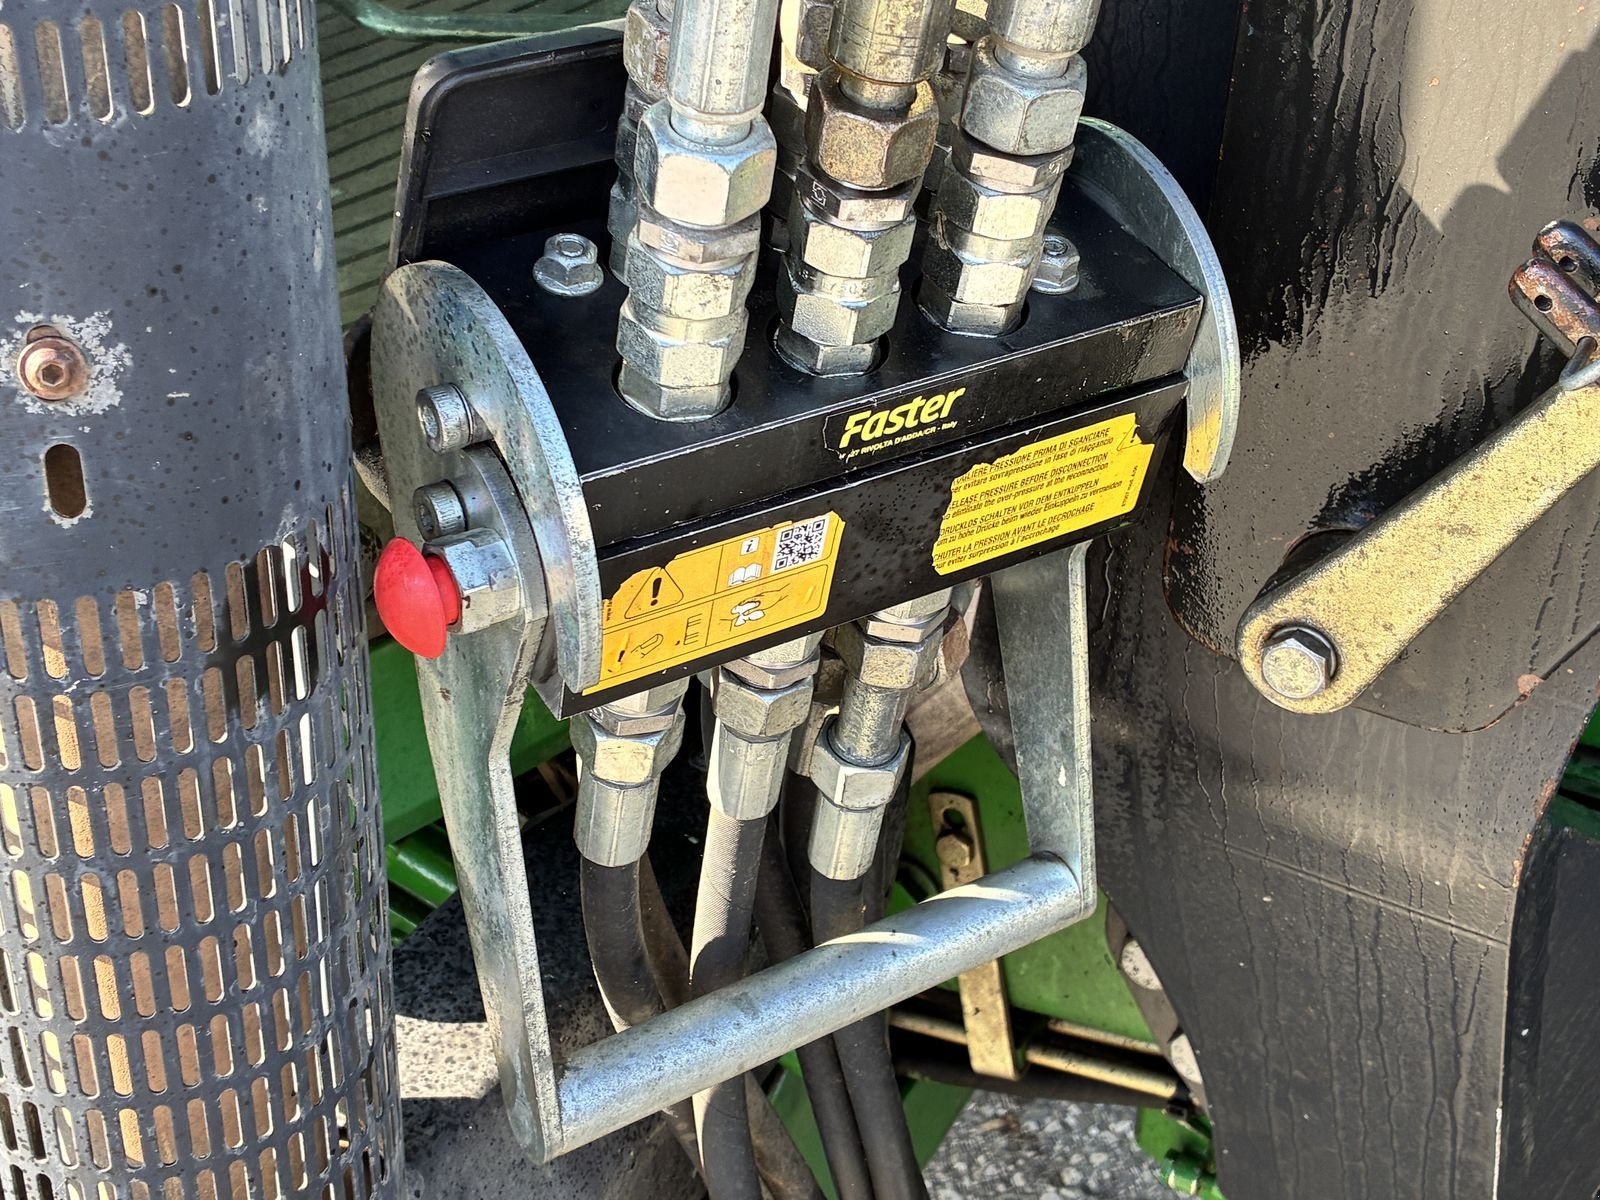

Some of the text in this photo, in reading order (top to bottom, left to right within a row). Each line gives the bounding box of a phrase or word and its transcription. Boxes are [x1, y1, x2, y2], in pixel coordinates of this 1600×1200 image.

[839, 387, 966, 449] Faster
[861, 439, 893, 455] RIVOLTA
[941, 420, 958, 431] Italy
[1033, 444, 1057, 460] PRIMA
[1059, 441, 1068, 451] DI
[1068, 428, 1110, 448] SGANCIARE
[979, 480, 1020, 500] PRESSURE
[1020, 470, 1050, 487] BEFORE
[1050, 452, 1108, 478] DISCONNECTION
[984, 498, 996, 508] the
[996, 483, 1044, 504] over-pressure
[1066, 462, 1109, 481] reconnection
[988, 459, 1043, 482] sovrapressione
[979, 505, 1017, 524] SCHALTEN
[1019, 499, 1035, 510] VOR
[1035, 493, 1052, 505] DEM
[1053, 478, 1099, 499] ENTKUPPELN
[962, 542, 972, 553] LA
[973, 530, 1010, 549] PRESSION
[1011, 522, 1035, 536] AVANT
[1037, 518, 1047, 527] LE
[968, 541, 1009, 560] surpression
